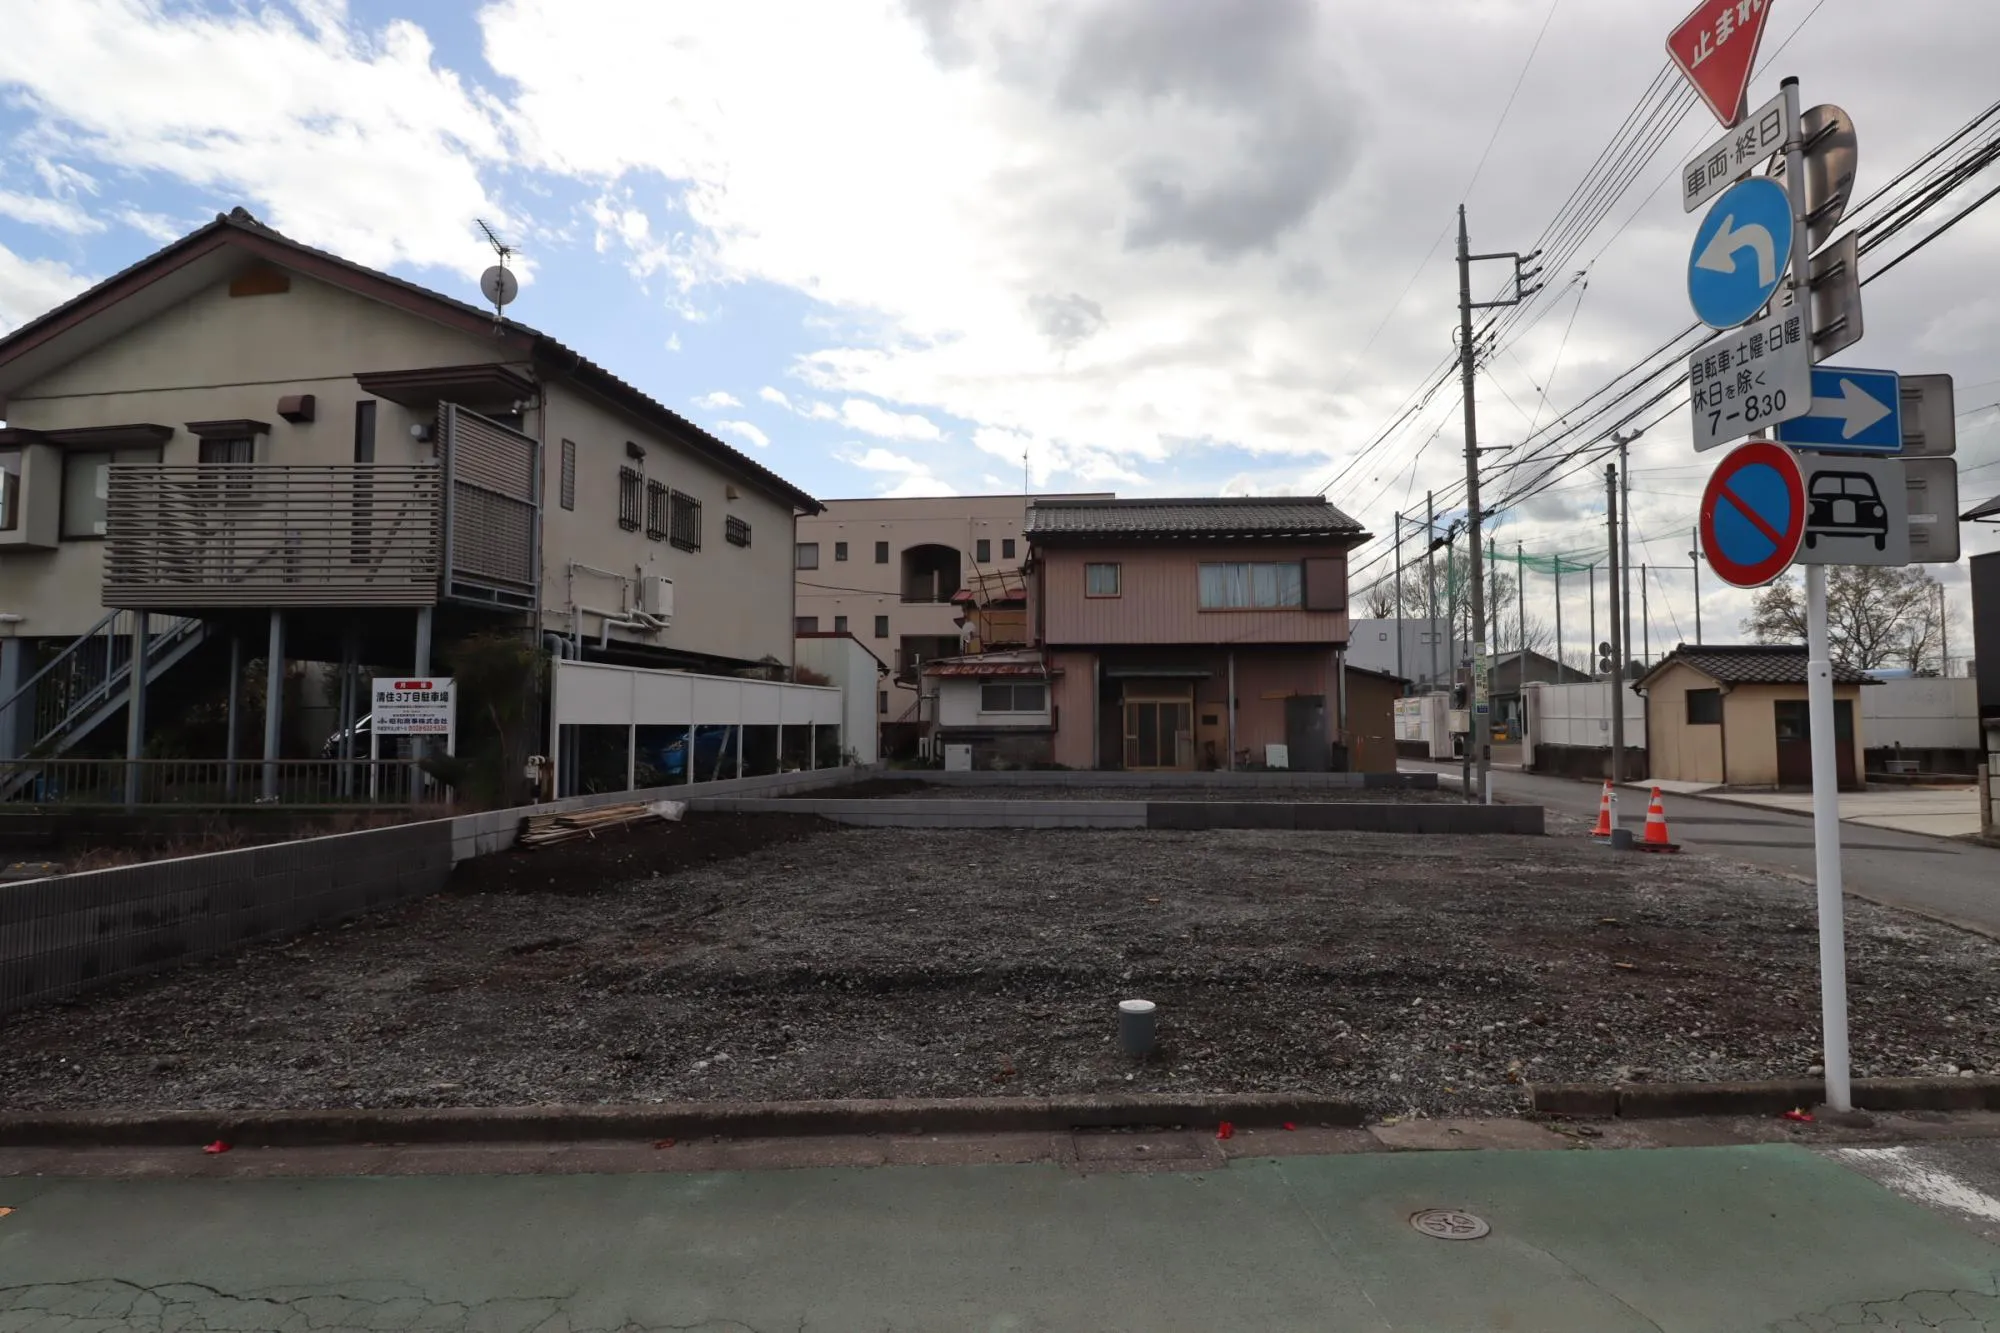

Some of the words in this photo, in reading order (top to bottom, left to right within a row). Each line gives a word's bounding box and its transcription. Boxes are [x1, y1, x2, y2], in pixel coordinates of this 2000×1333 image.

[1687, 109, 1781, 197] 車両・終日
[1692, 316, 1801, 386] 自転車・土曜・日曜
[1692, 368, 1766, 414] 休日を除く
